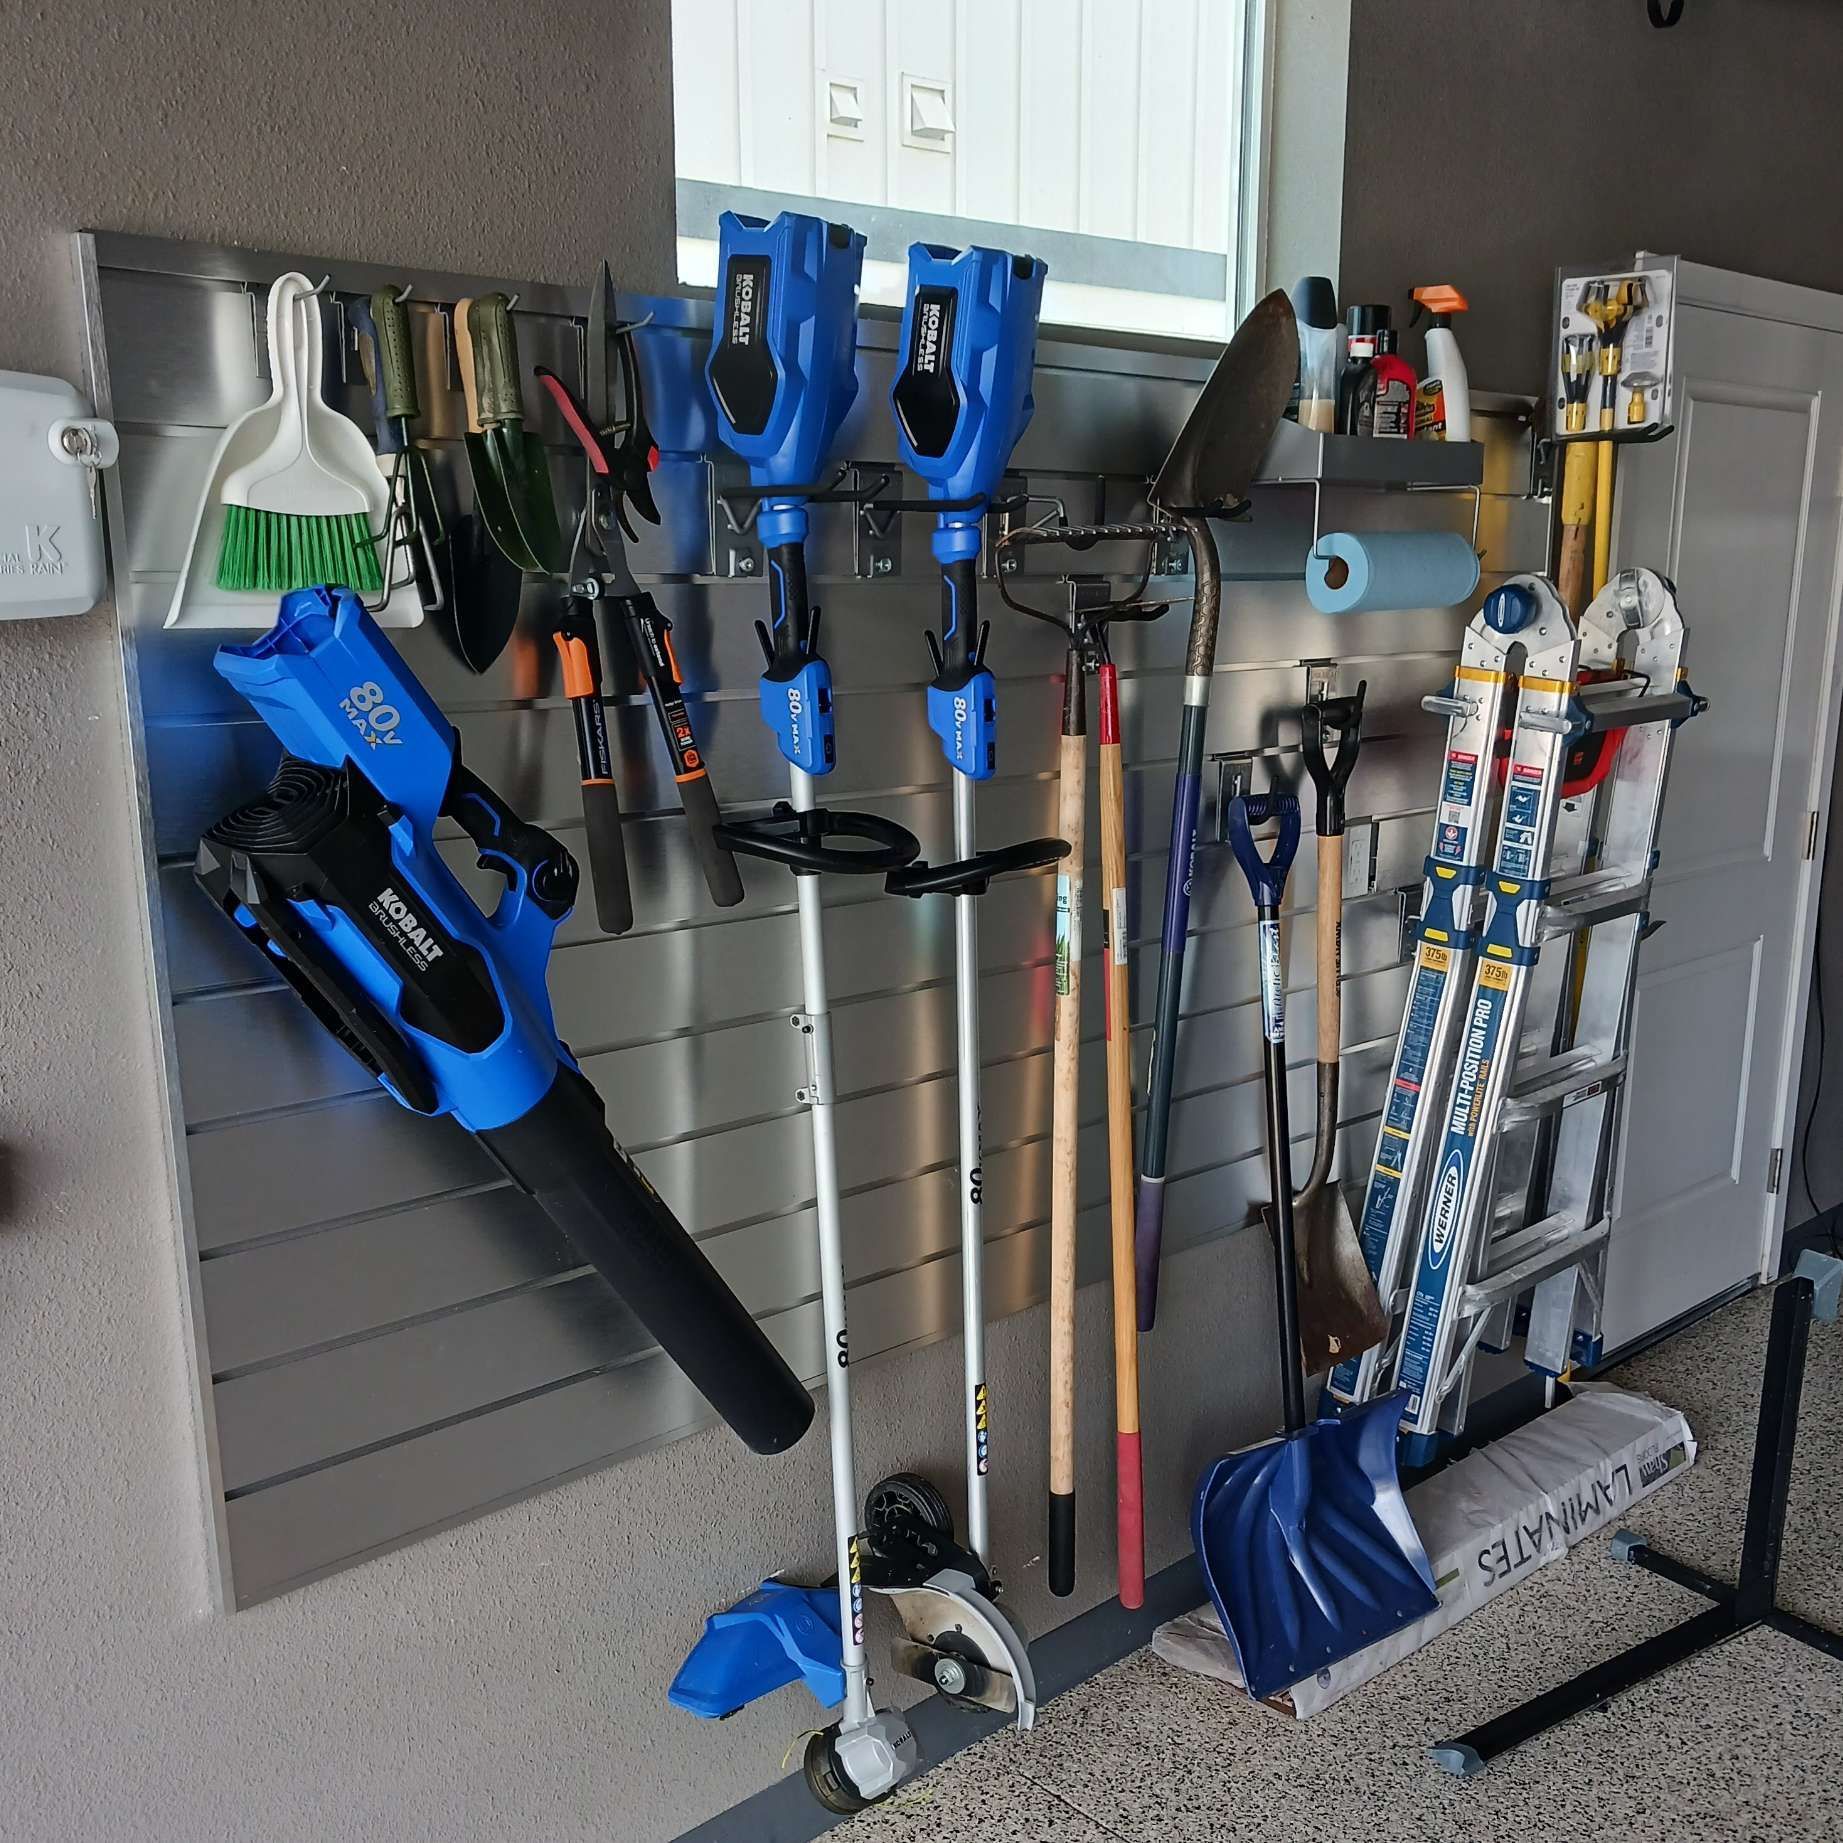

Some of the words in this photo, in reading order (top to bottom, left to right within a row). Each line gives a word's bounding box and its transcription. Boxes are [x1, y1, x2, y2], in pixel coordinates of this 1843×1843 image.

[739, 273, 754, 345] KOBALT
[924, 304, 940, 373] KOBALT
[30, 561, 64, 577] RAIN
[338, 699, 384, 751] MAX
[593, 701, 608, 775] FISKARS
[790, 723, 801, 755] MAX
[367, 901, 428, 973] BRUSHLESS
[377, 886, 444, 963] KOBALT
[1451, 1028, 1485, 1135] MULTI-POSITION
[1475, 999, 1492, 1029] PRO
[1435, 1173, 1457, 1244] WERNER
[1478, 1464, 1633, 1586] LAMINATES
